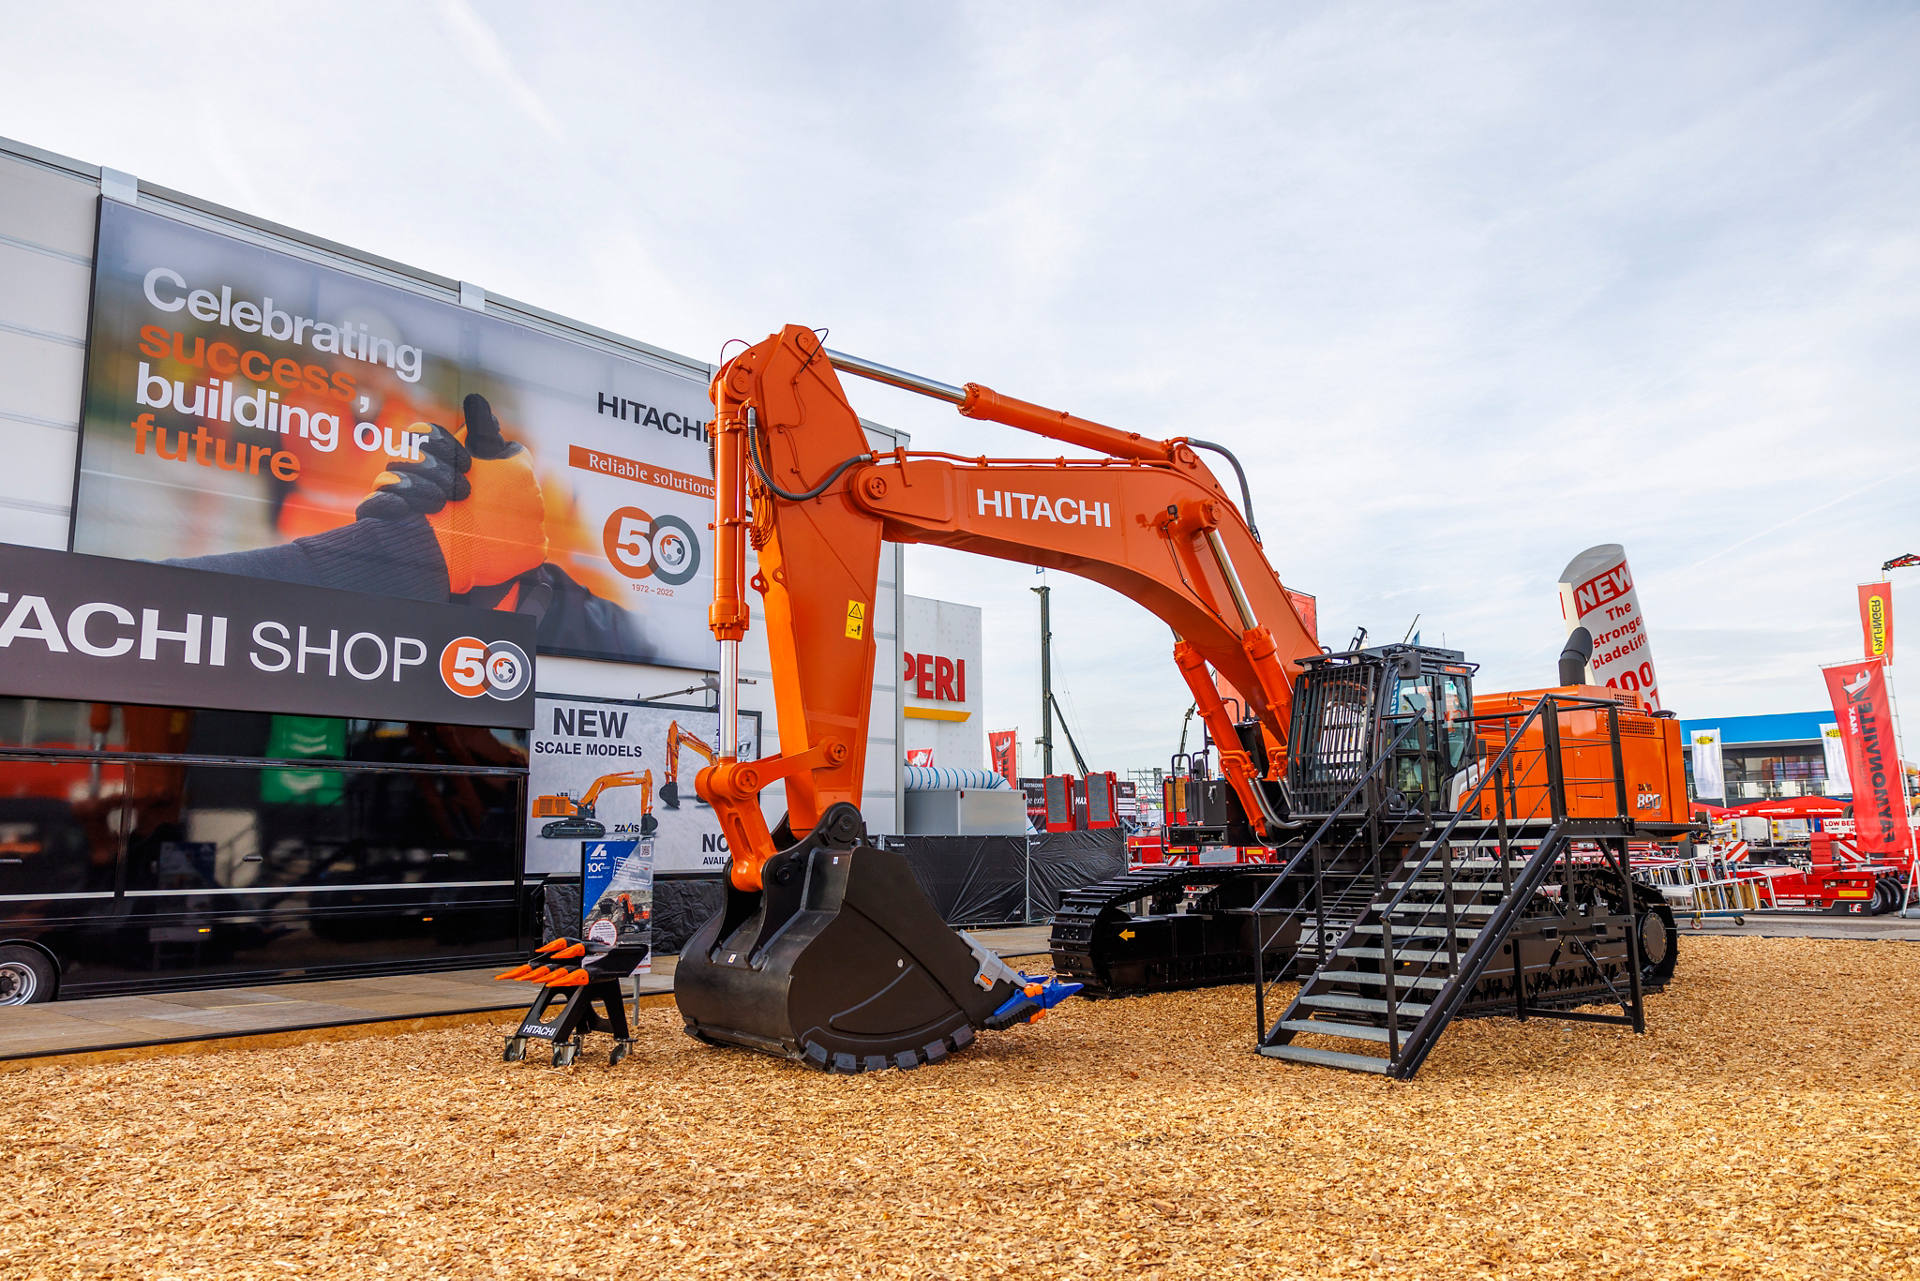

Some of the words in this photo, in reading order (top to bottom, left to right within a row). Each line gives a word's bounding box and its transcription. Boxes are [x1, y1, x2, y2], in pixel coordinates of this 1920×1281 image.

[143, 267, 423, 383] Celebrating
[138, 324, 370, 414] success,
[136, 361, 339, 453] building
[353, 421, 429, 462] our
[131, 413, 302, 482] future
[588, 452, 649, 481] Reliable
[653, 470, 716, 497] solutions
[976, 488, 1112, 528] HITACHI
[631, 583, 650, 593] 1972
[656, 586, 674, 598] 2022
[1578, 566, 1633, 612] NEW
[1605, 602, 1632, 622] The
[0, 592, 228, 667] ACHI
[249, 621, 428, 683] SHOP
[553, 707, 629, 739] NEW
[535, 741, 582, 755] SCALE
[586, 743, 642, 758] MODELS
[614, 822, 640, 833] ZAXIS
[702, 833, 729, 853] NO
[522, 1023, 557, 1037] HITACHI
